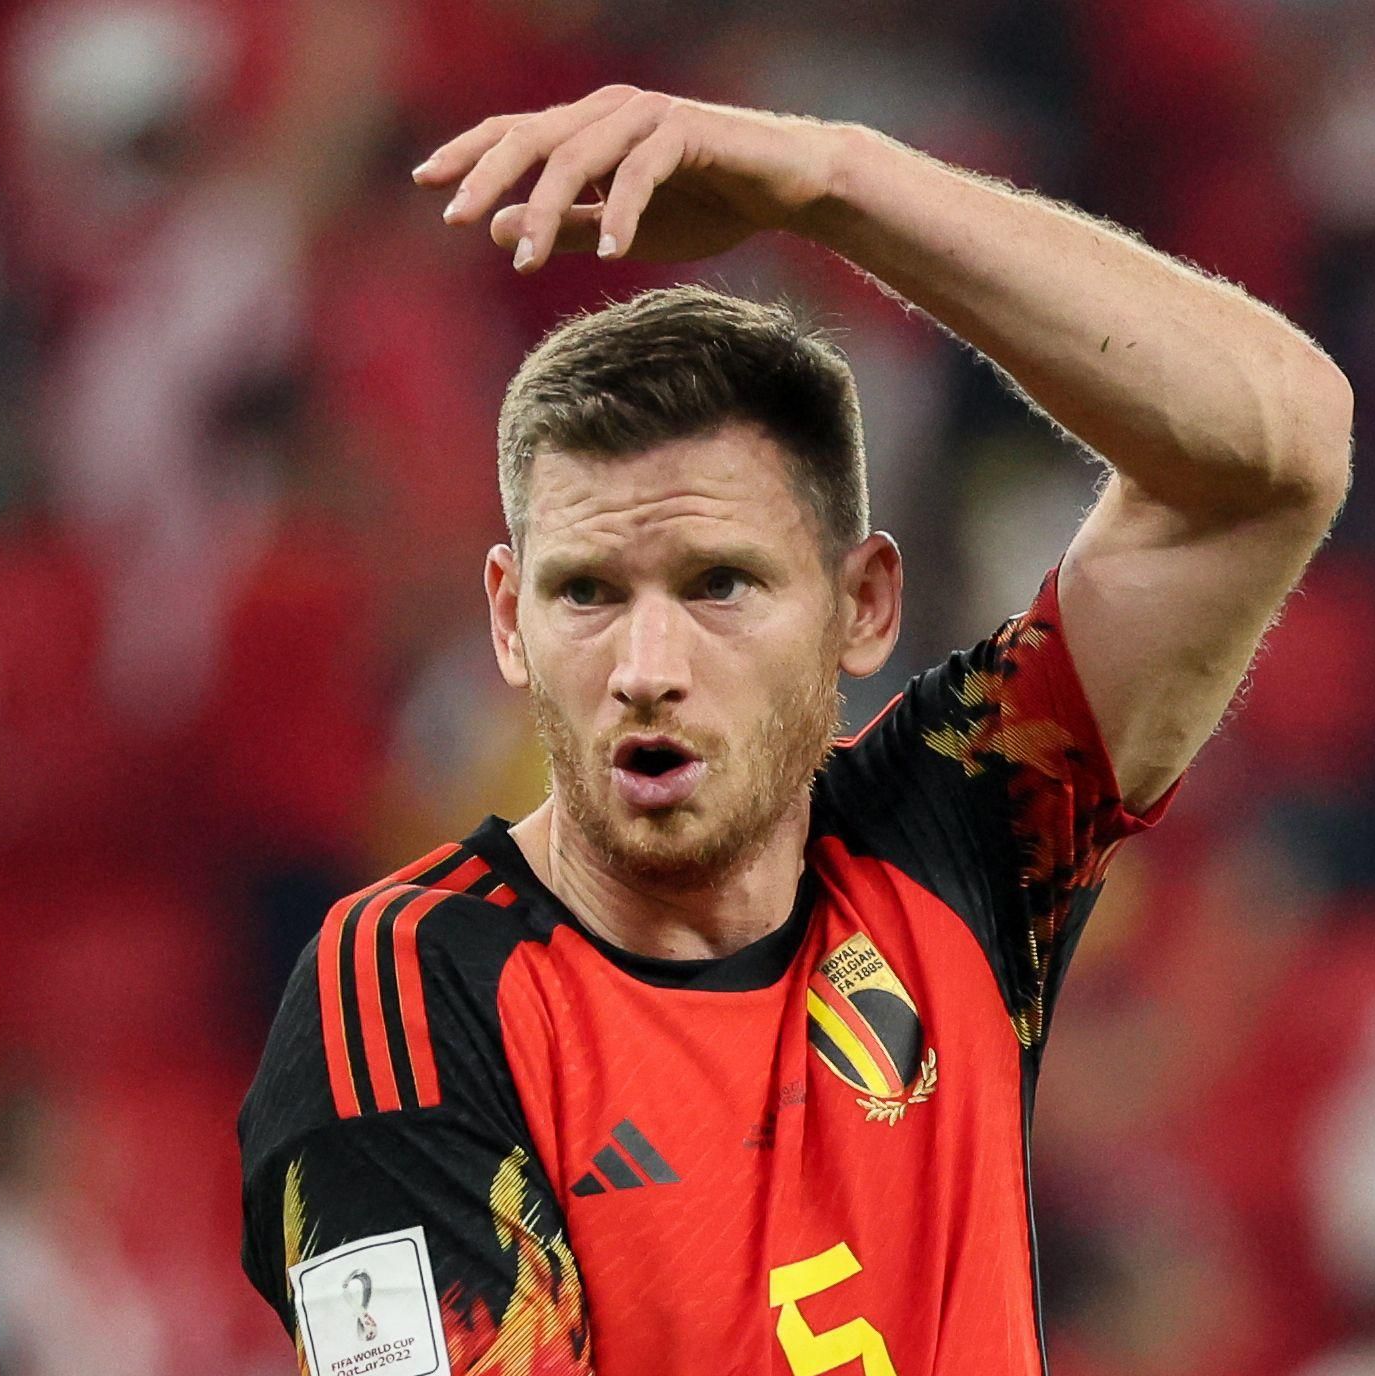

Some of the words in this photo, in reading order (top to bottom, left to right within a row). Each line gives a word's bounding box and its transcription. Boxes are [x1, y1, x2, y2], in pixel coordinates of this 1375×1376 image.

[821, 946, 858, 975] ROYAL
[829, 947, 876, 984] BELGIAN
[331, 1357, 353, 1372] FIFA
[353, 1343, 392, 1363] WORLD
[393, 1337, 416, 1350] CUP
